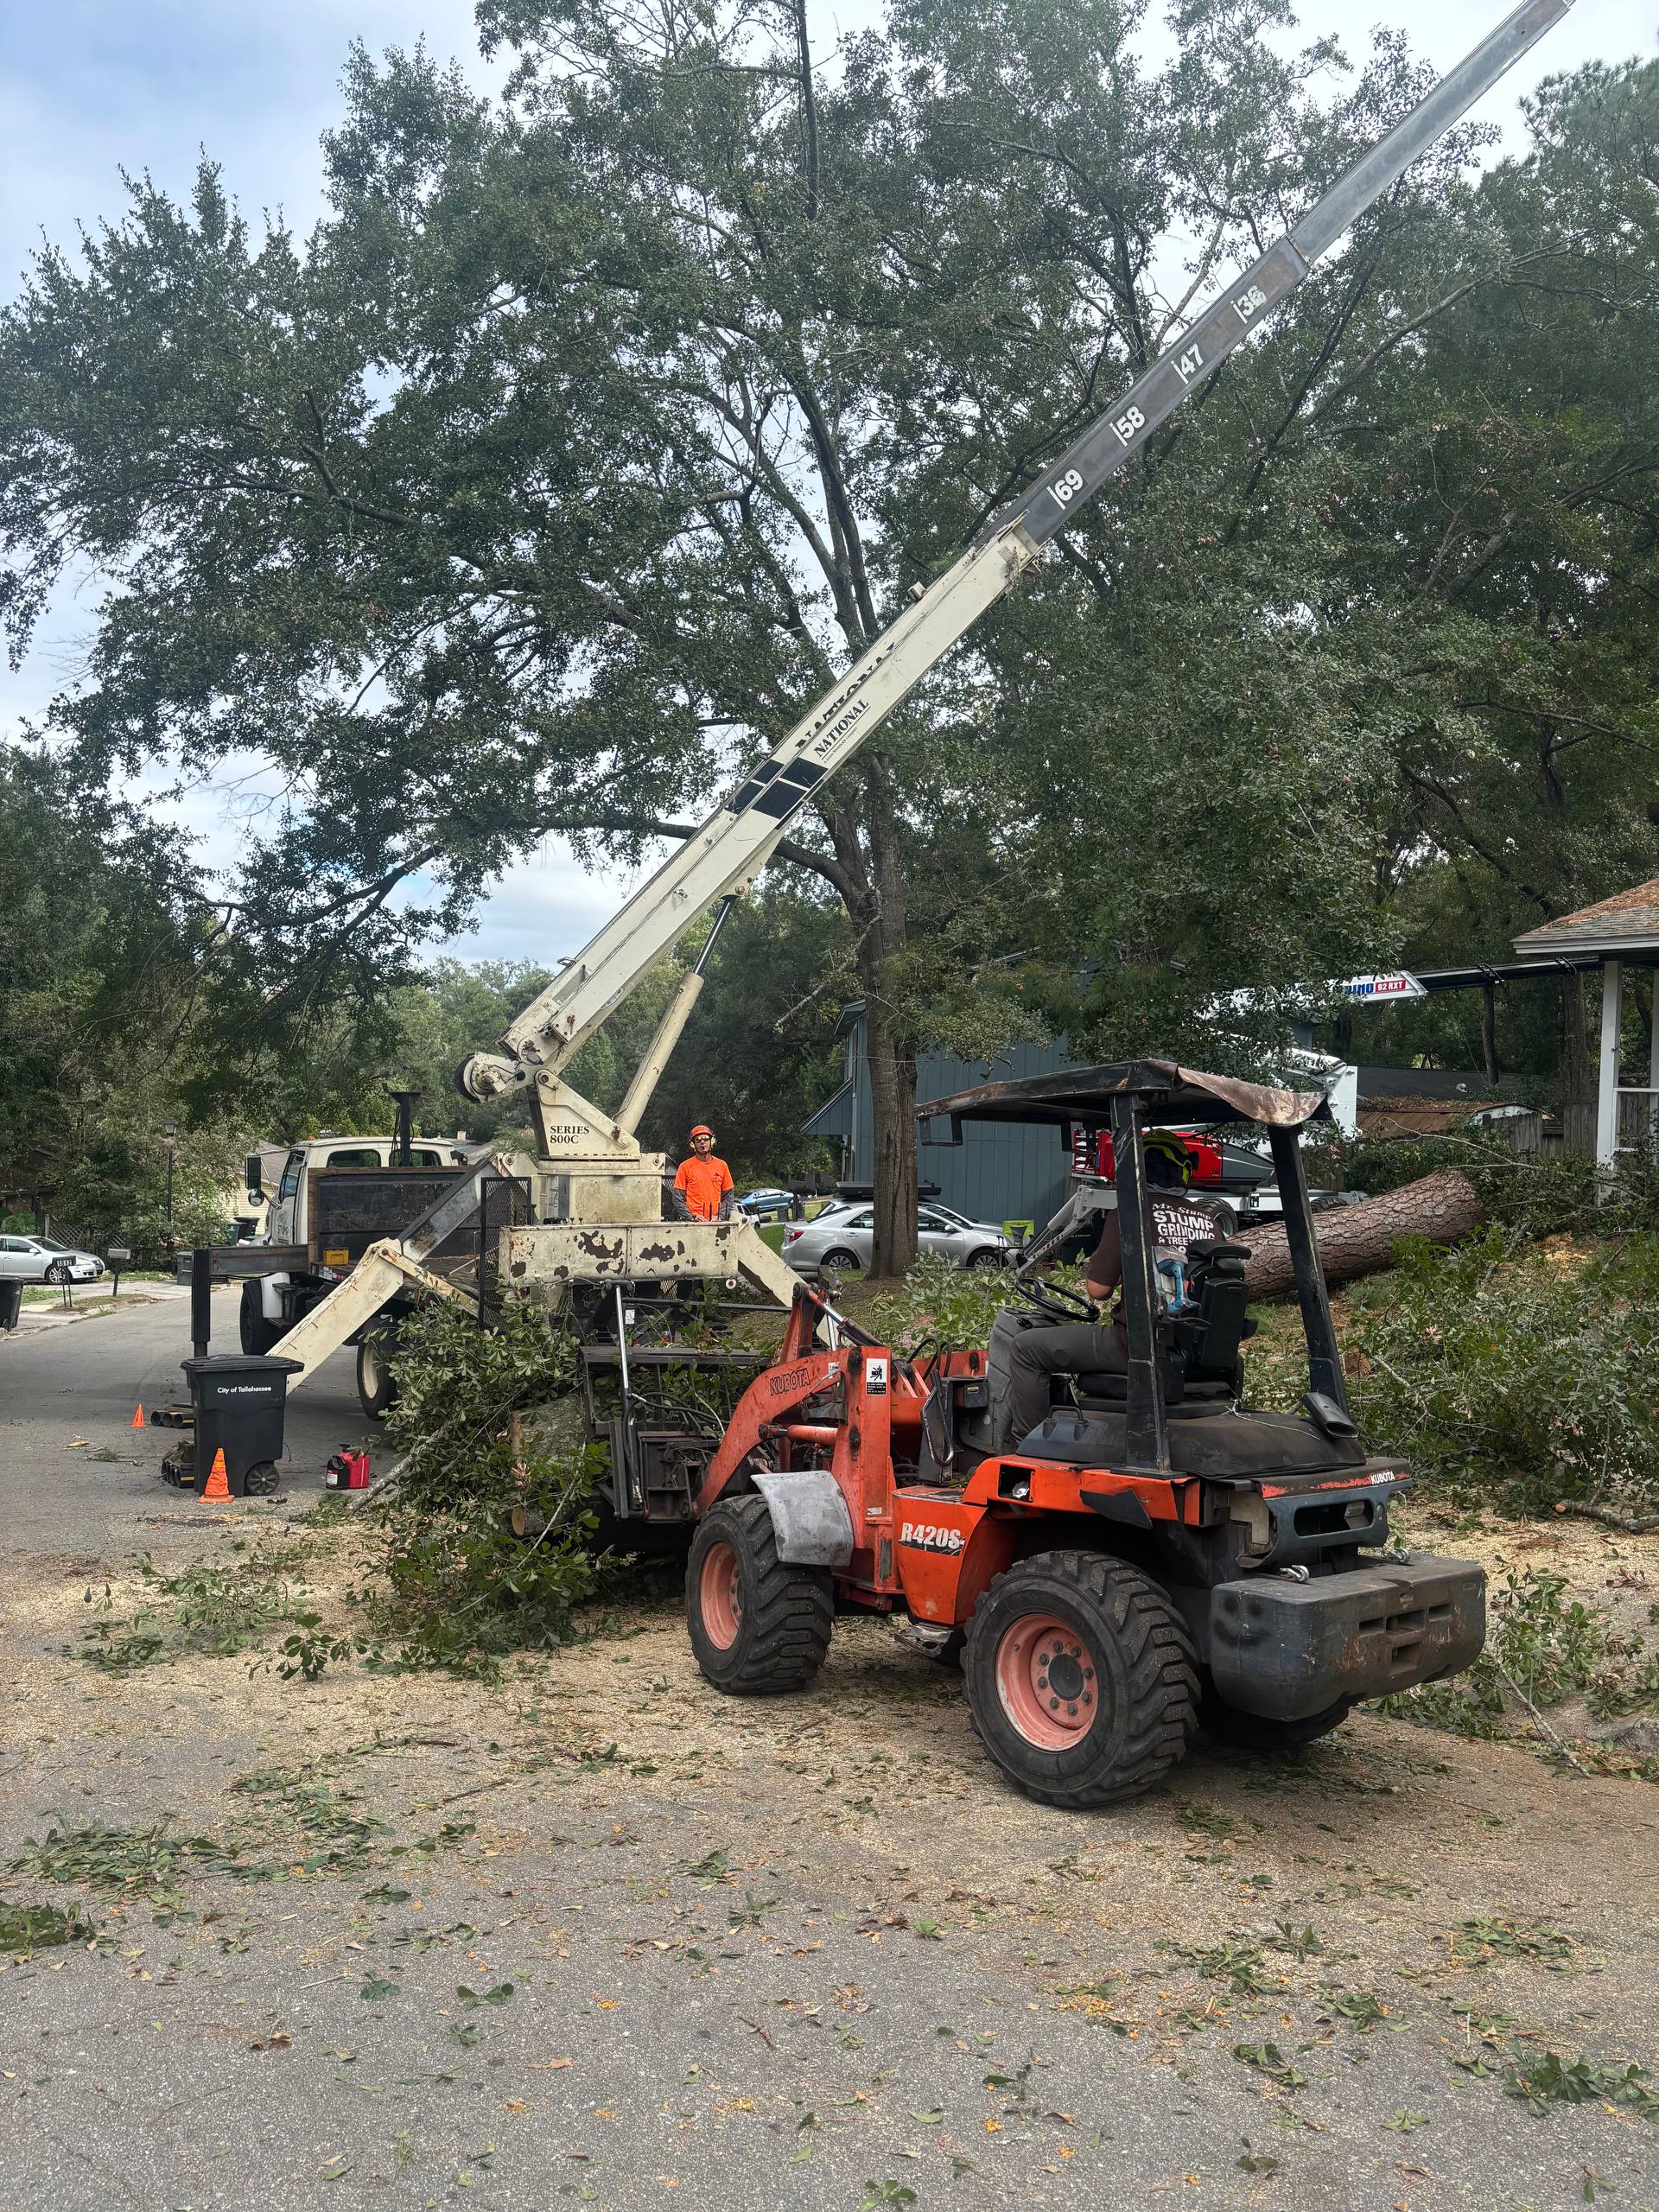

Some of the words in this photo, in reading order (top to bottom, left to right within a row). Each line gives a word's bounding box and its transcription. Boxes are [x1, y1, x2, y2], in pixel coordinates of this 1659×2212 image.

[1180, 344, 1205, 375] 47
[1122, 406, 1145, 439] 58
[1055, 469, 1084, 501] 69
[814, 699, 869, 758] NATIONAL
[550, 1125, 589, 1135] SERIES
[550, 1135, 579, 1144] 800C
[1153, 1210, 1214, 1231] STUMP
[1178, 1206, 1211, 1220] Stump
[1158, 1223, 1216, 1241] GRINDING
[1166, 1236, 1189, 1246] TREE
[770, 1368, 810, 1396] KUBOTA
[1370, 1471, 1396, 1485] KUBOTA
[900, 1522, 961, 1549] R420S
